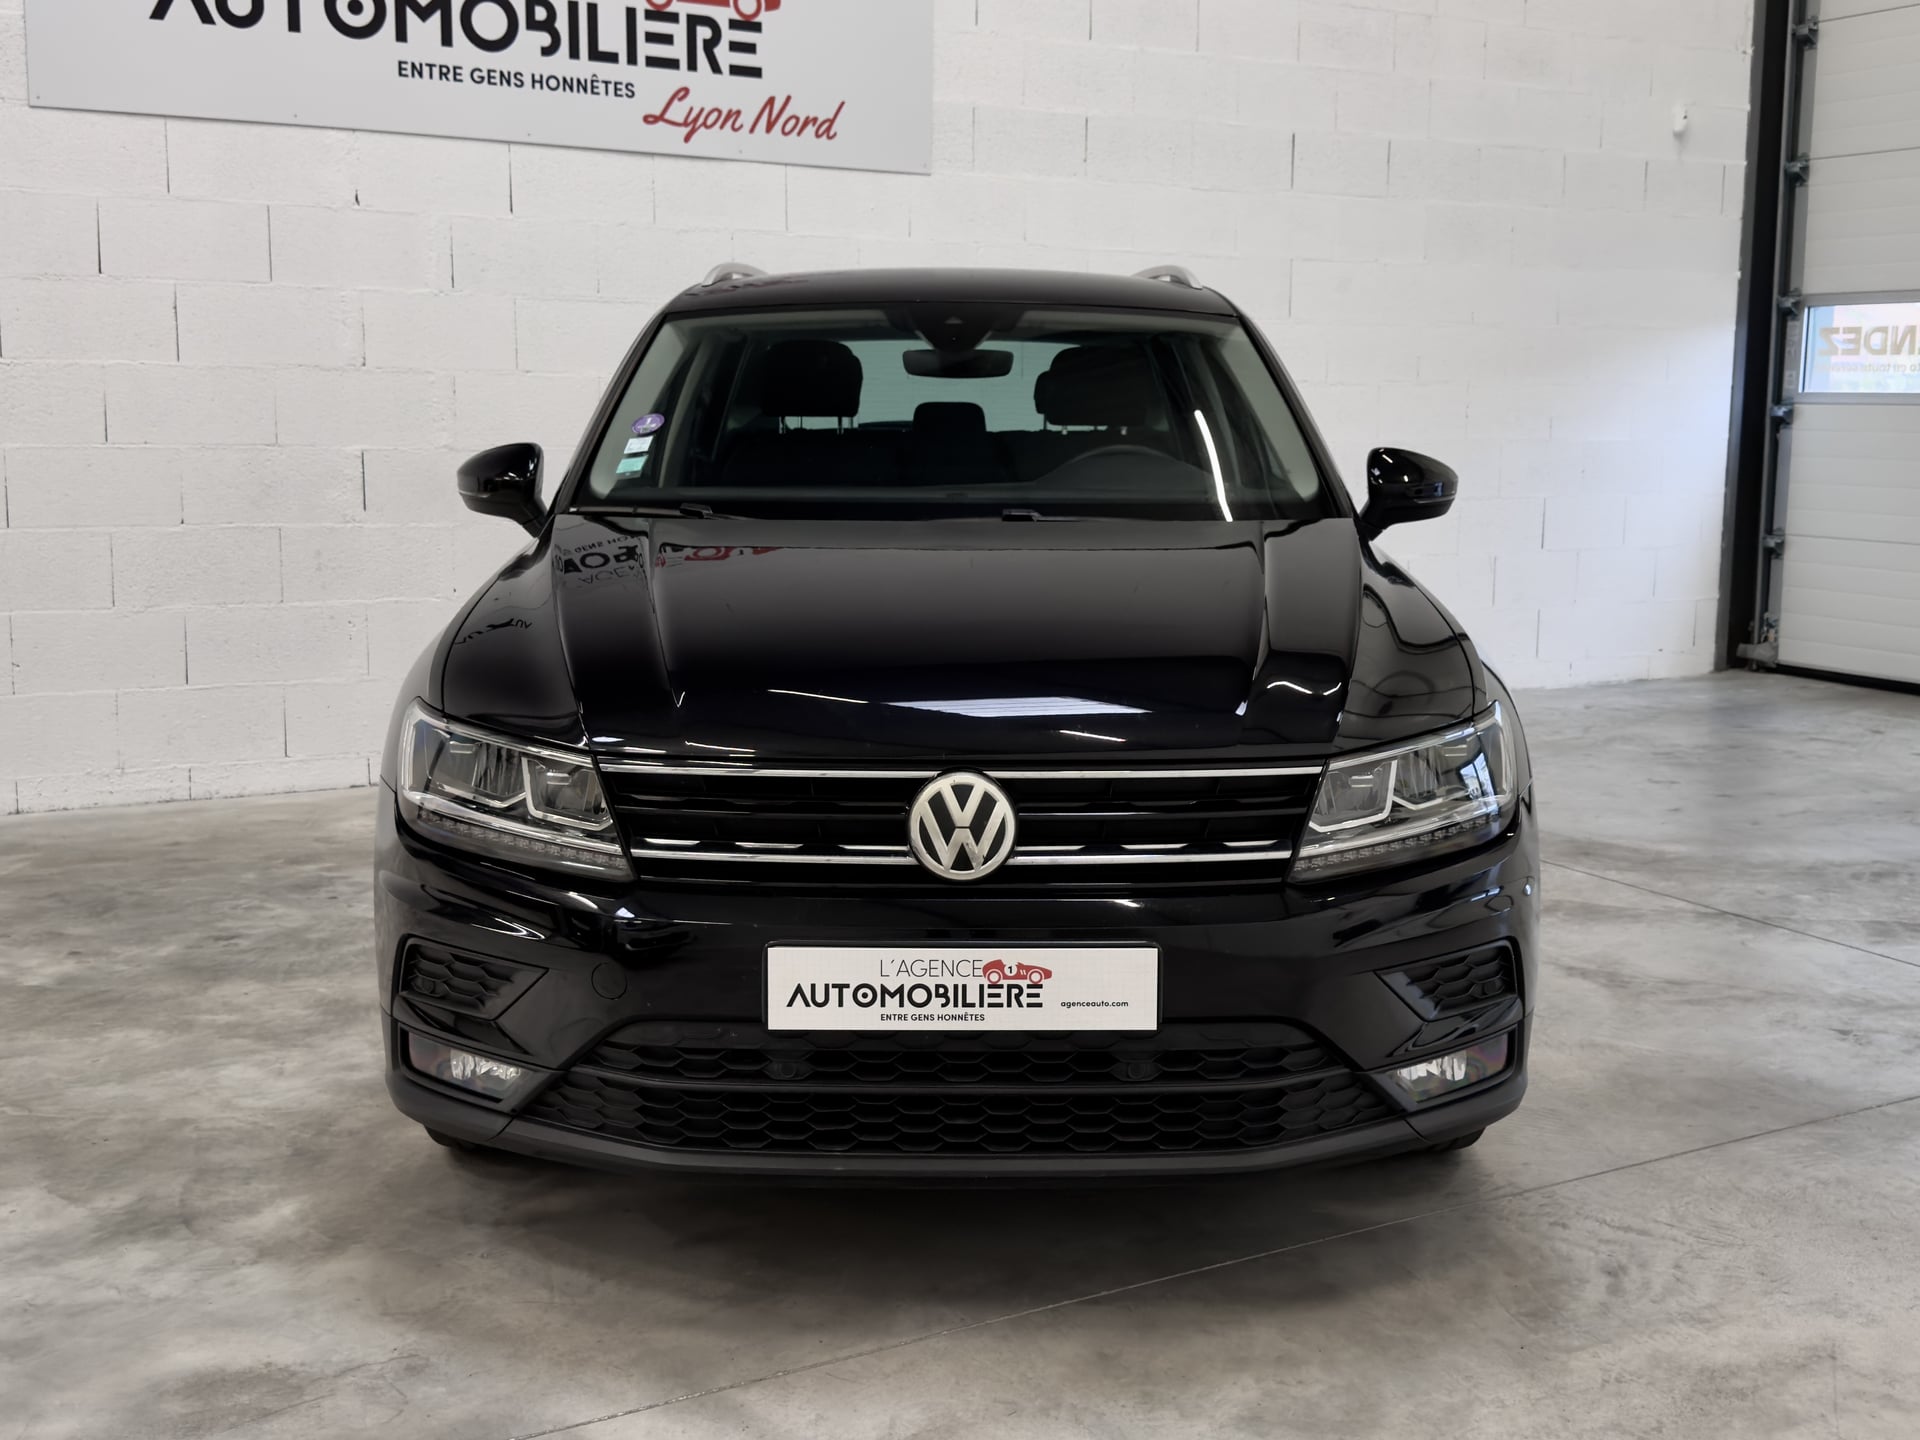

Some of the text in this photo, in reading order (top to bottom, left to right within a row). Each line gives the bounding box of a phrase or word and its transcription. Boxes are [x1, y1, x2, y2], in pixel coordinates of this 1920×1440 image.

[398, 60, 636, 99] ENTRE GENS HONNÊTES
[642, 86, 846, 144] Lyon Nord
[910, 772, 1015, 880] VW
[880, 959, 983, 977] L'AGENCE
[786, 983, 1043, 1008] AUTOMOBILIERE
[1060, 1000, 1129, 1009] agenceauto.com
[880, 1011, 985, 1021] ENTRE GENS HONNÊTES
